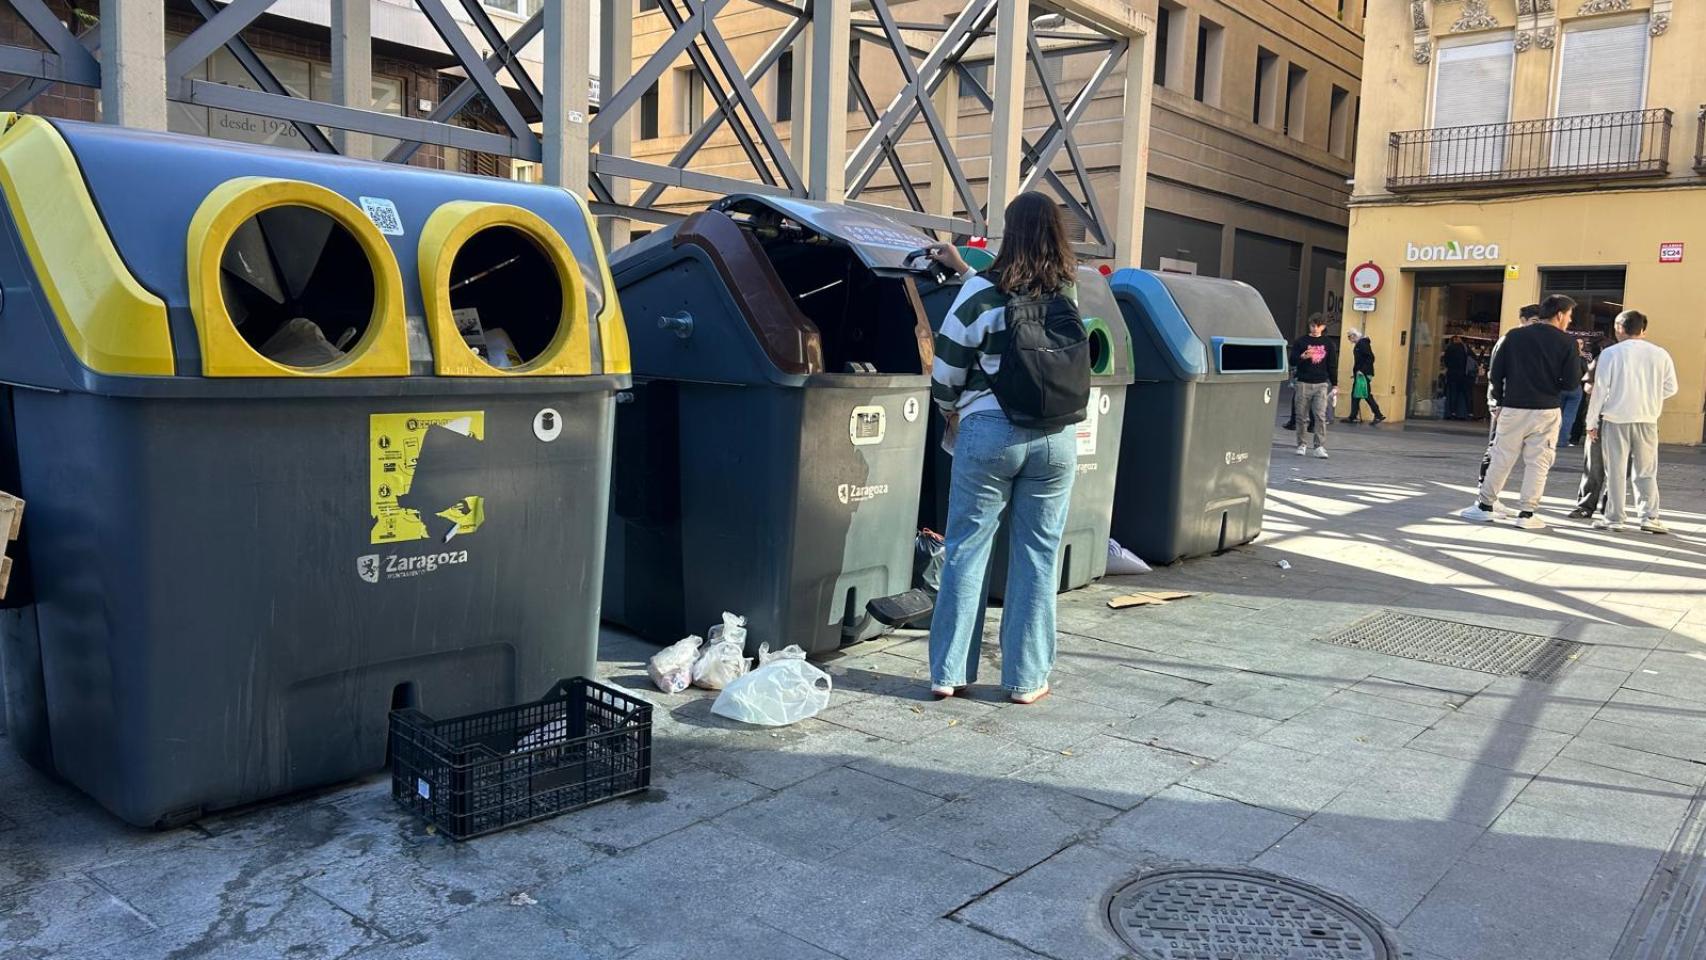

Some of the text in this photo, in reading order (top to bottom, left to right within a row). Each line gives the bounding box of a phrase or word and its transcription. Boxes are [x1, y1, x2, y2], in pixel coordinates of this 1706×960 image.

[221, 113, 298, 137] desde 1926
[1406, 240, 1500, 261] bonArea
[850, 484, 889, 499] Zaragoza
[385, 550, 468, 572] Zaragoza
